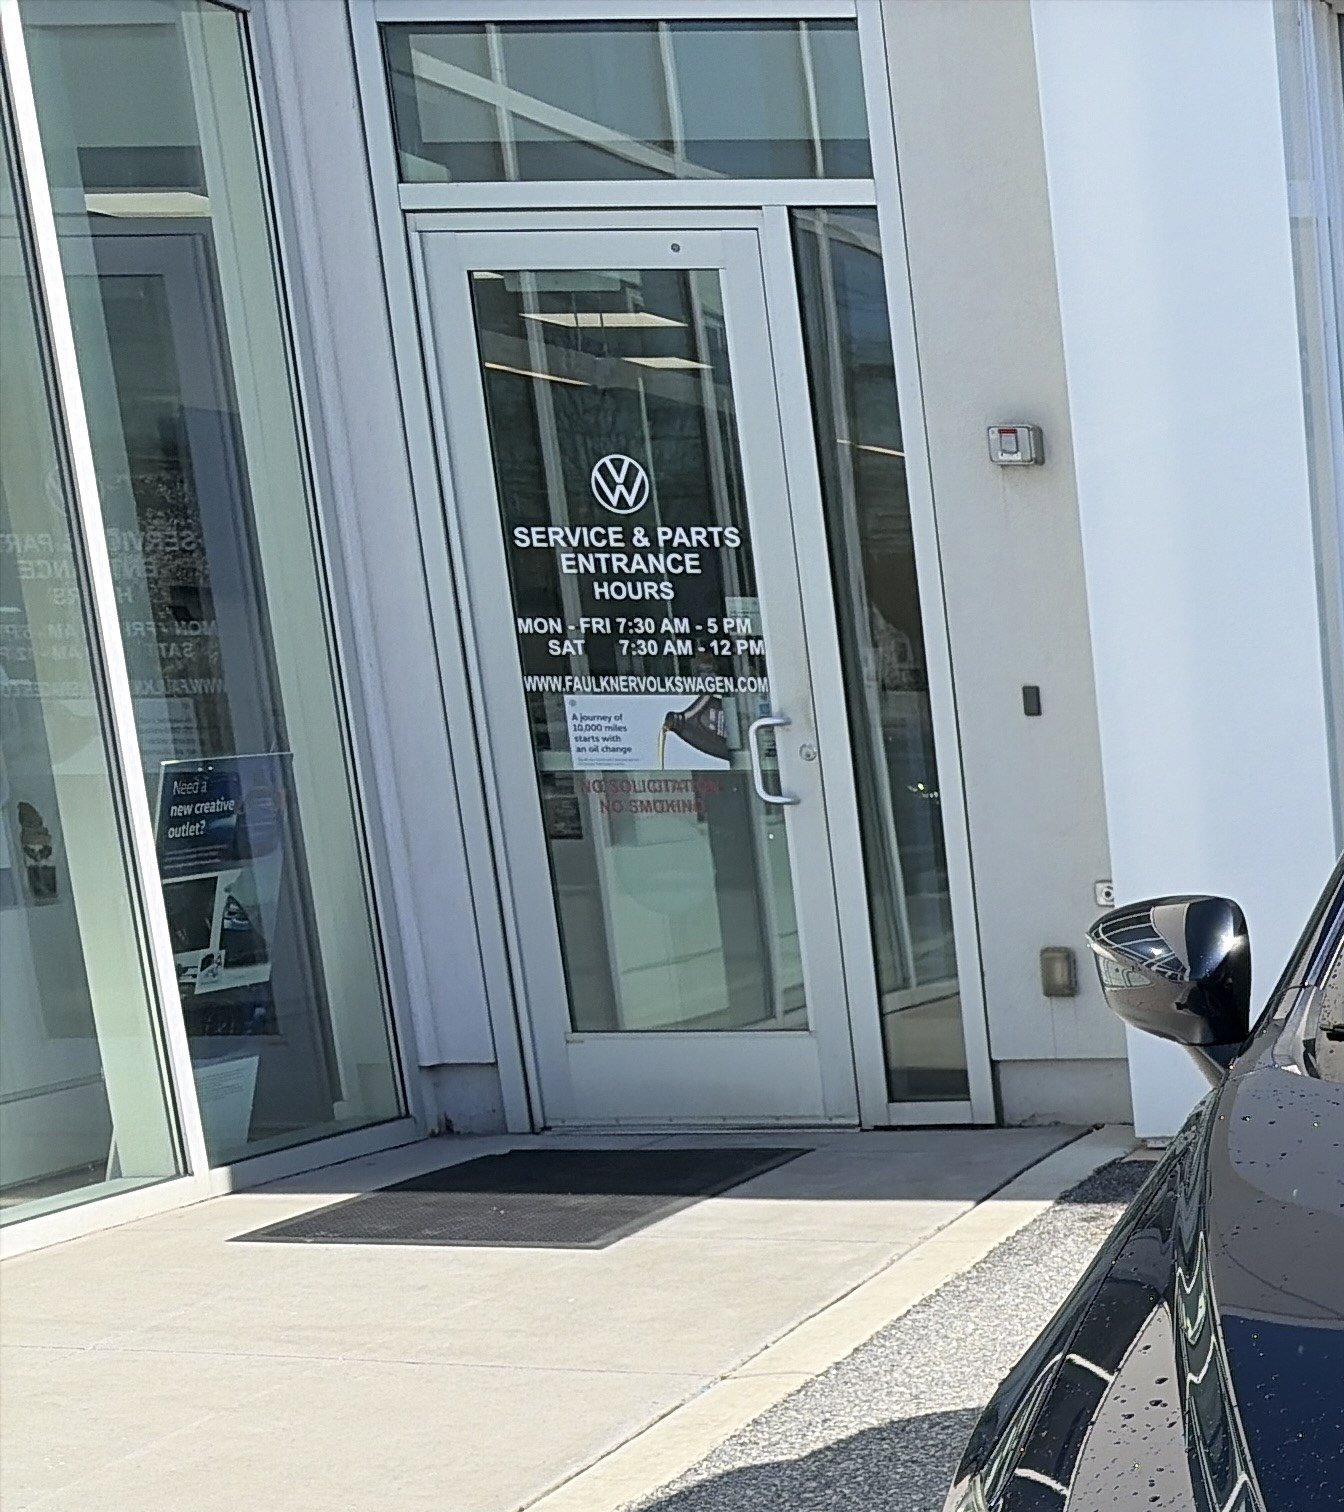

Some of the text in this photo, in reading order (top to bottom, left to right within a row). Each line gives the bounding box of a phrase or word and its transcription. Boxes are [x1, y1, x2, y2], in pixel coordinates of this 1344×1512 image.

[513, 526, 741, 548] SERVICE & PARTS
[560, 553, 702, 574] ENTRANCE
[593, 581, 675, 600] HOURS
[517, 617, 563, 634] MON
[579, 617, 612, 634] FRI
[615, 617, 656, 634] 7:30
[660, 617, 690, 634] AM
[707, 617, 719, 634] 5
[722, 617, 752, 634] PM
[548, 639, 586, 656] SAT
[618, 639, 659, 656] 7:30
[663, 639, 693, 656] AM
[709, 639, 732, 656] 12
[735, 639, 766, 656] PM
[523, 675, 769, 693] WWW.FAULKNERVOLKSWAGEN.COM
[572, 713, 623, 723] A journey of
[572, 723, 628, 732] 10,000 miles
[574, 734, 622, 743] starts with
[588, 745, 599, 753] oil
[600, 745, 632, 755] change
[173, 779, 207, 795] Need a
[581, 779, 605, 793] NO
[170, 796, 235, 817] new creative
[601, 799, 624, 814] NO
[168, 819, 206, 839] outlet?
